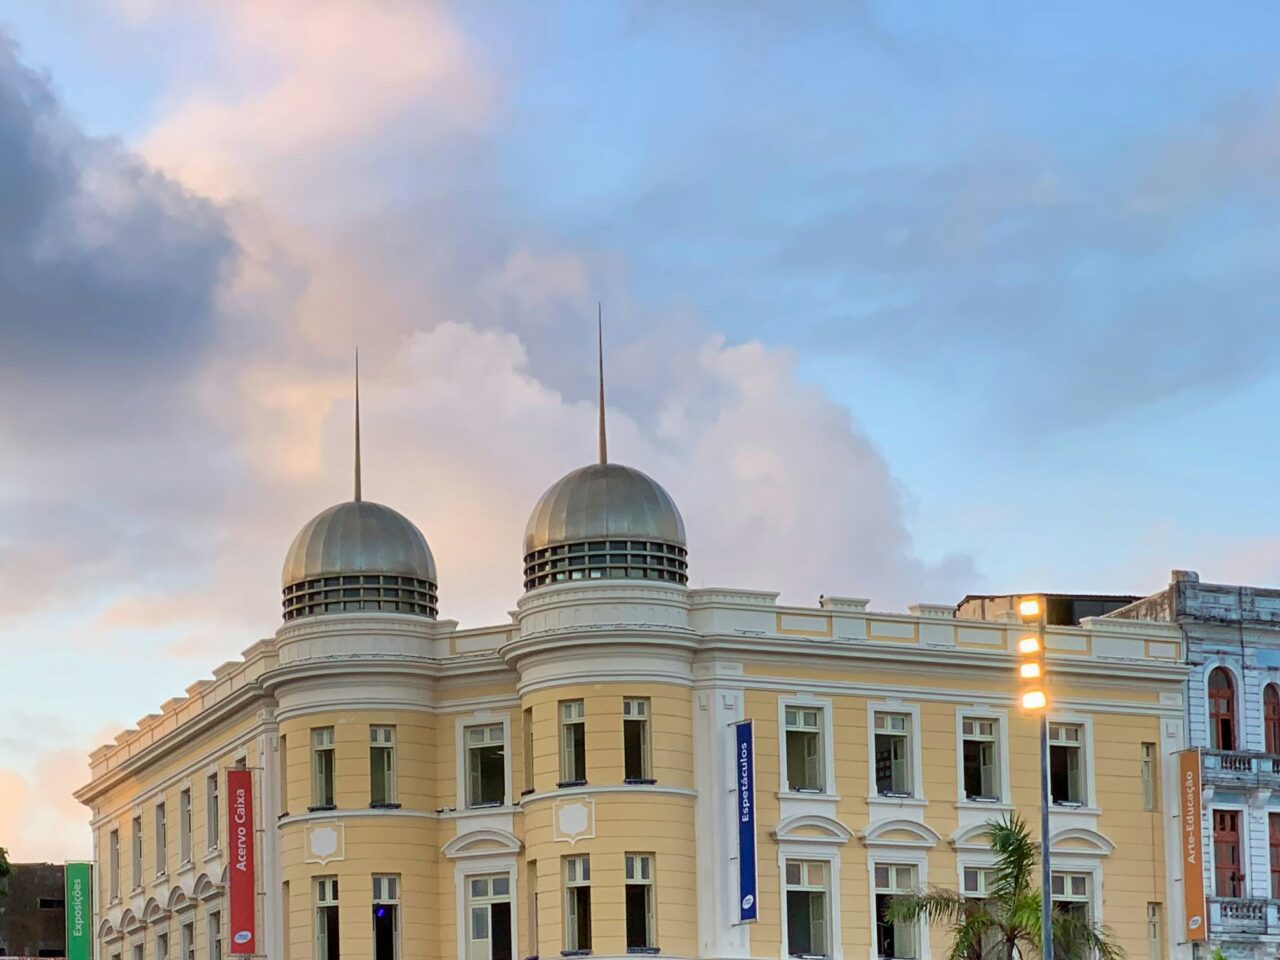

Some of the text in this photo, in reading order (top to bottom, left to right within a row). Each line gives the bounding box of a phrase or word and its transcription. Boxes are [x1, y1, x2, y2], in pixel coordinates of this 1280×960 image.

[740, 742, 749, 822] Espetáculos
[1185, 771, 1195, 864] Arte-Educação
[235, 788, 246, 871] Acervo Caixa
[73, 878, 84, 937] Exposições
